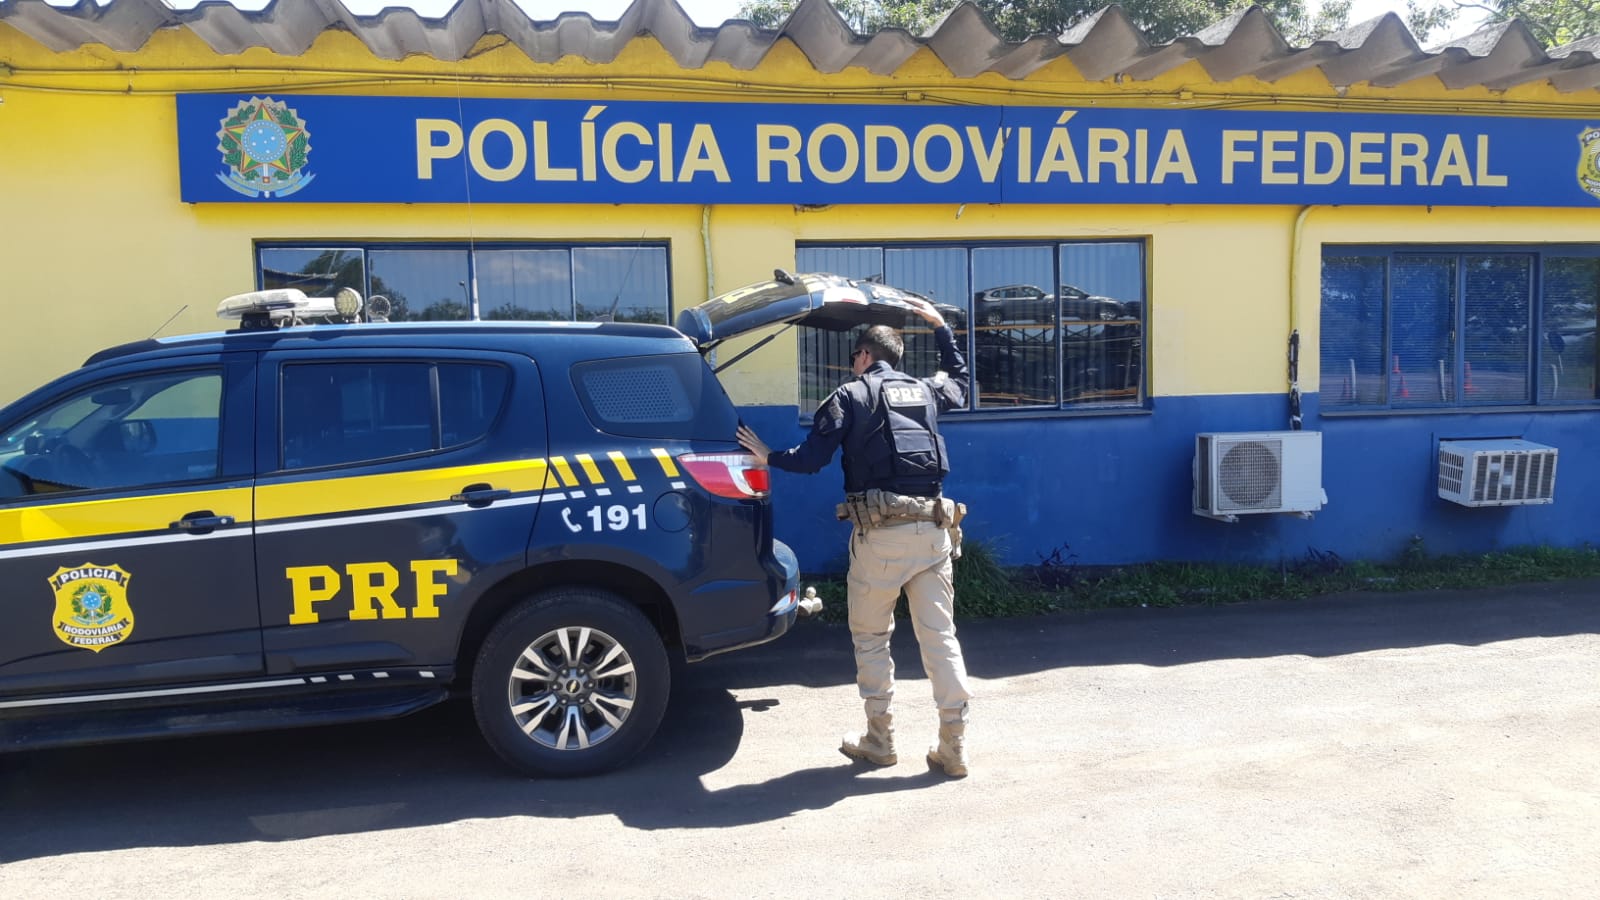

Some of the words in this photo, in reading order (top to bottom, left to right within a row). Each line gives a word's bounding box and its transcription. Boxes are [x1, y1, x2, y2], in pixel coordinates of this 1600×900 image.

[416, 105, 732, 184] POLÍCIA
[756, 110, 1198, 185] RODOVIÁRIA
[1221, 129, 1508, 187] FEDERAL
[887, 386, 924, 402] PRF
[588, 502, 647, 533] 191
[285, 558, 459, 625] PRF
[74, 635, 117, 645] FEDERAL
